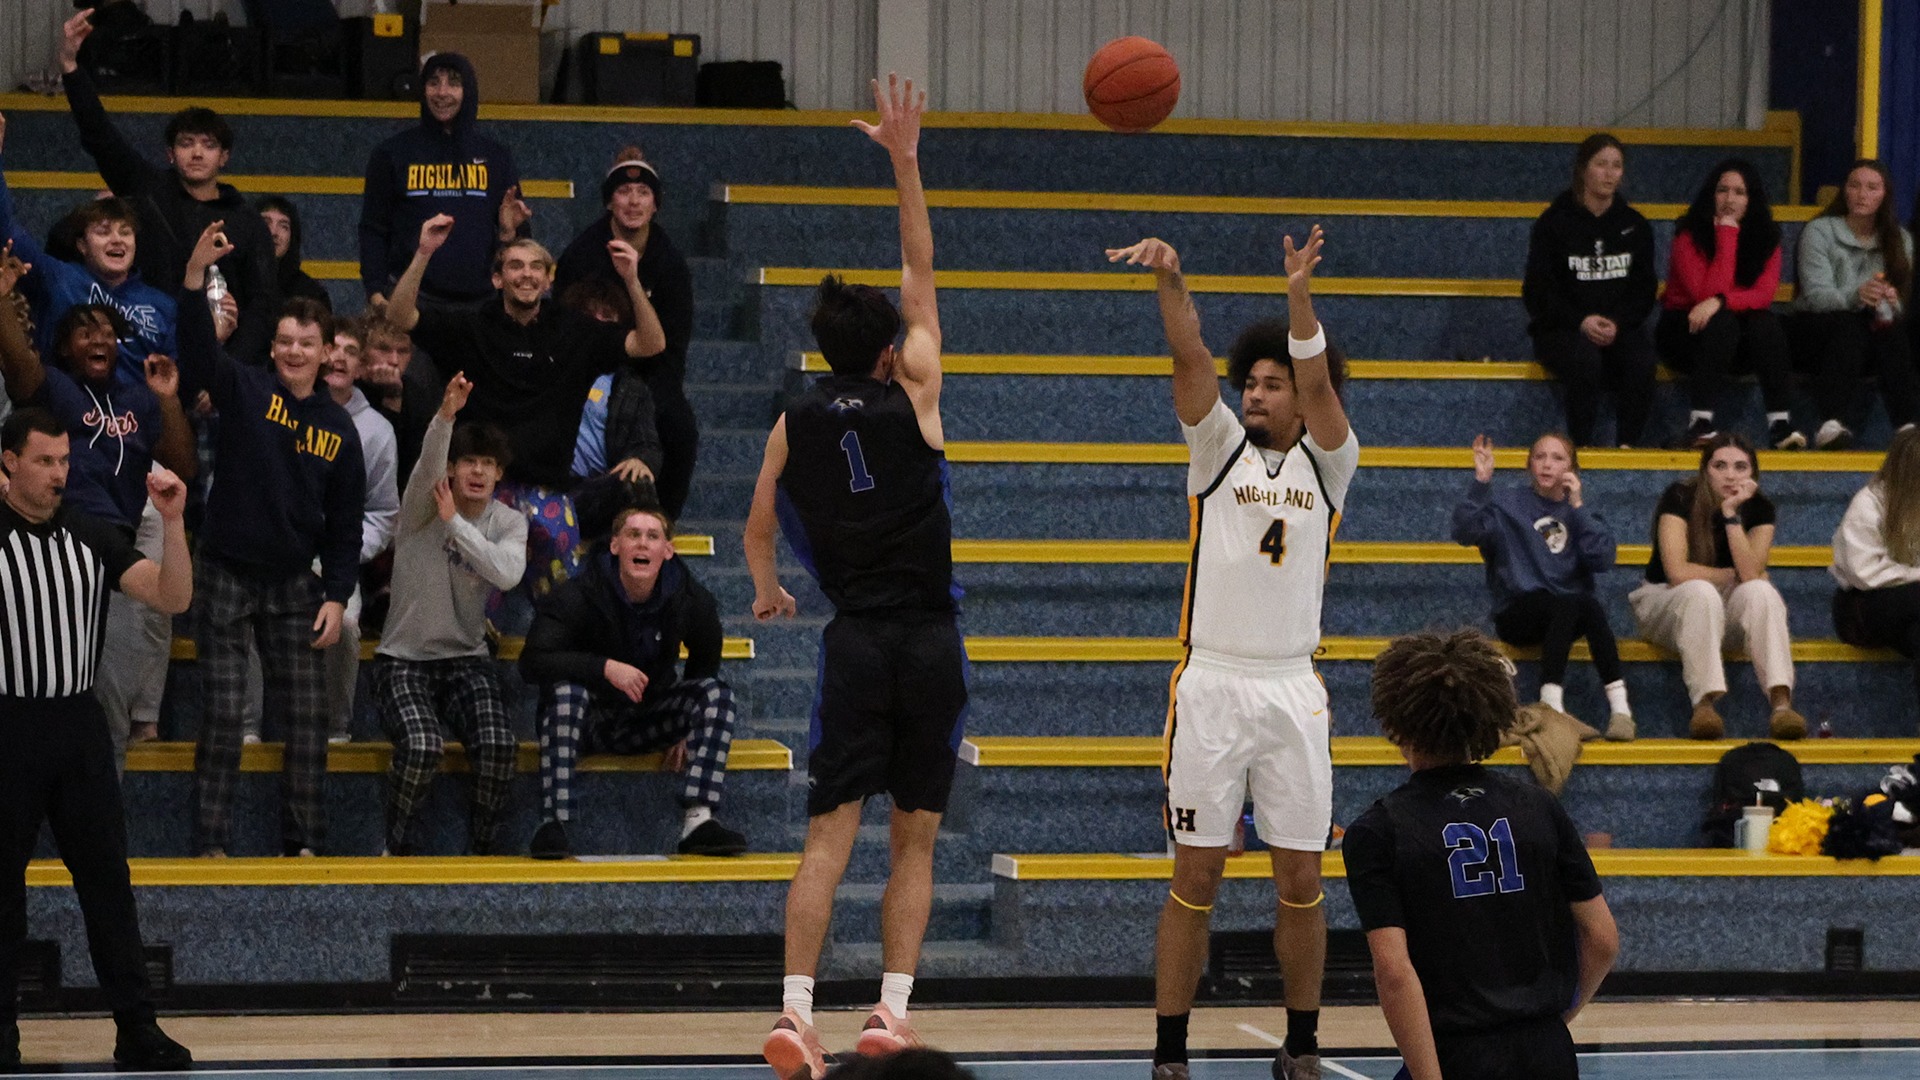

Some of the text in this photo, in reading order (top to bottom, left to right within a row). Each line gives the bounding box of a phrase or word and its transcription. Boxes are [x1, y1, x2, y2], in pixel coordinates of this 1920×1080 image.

[407, 163, 488, 190] HIGHLAND
[840, 430, 875, 493] 1
[1233, 485, 1315, 511] HIGHLAND
[1259, 518, 1288, 567] 4
[1175, 806, 1196, 832] H
[1442, 817, 1525, 899] 21
